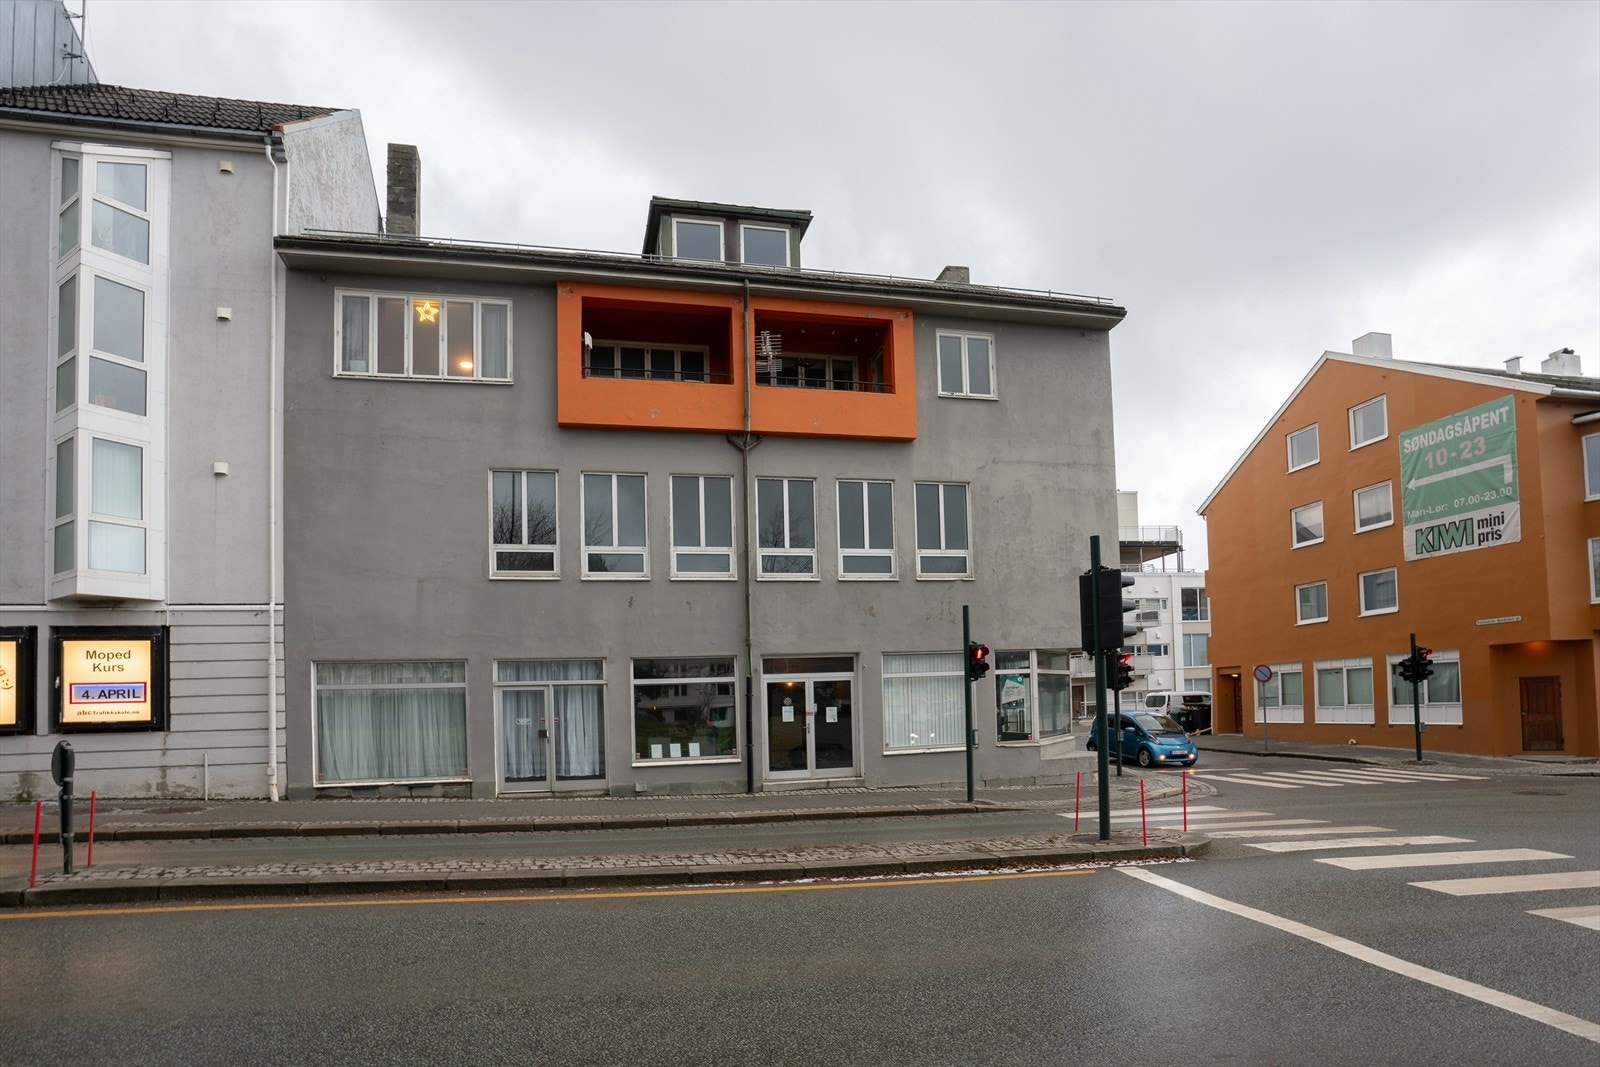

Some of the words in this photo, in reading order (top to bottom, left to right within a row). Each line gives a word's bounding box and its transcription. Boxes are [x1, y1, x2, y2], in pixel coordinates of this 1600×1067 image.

[1403, 406, 1510, 454] SØNDAGSÅPENT
[1424, 447, 1448, 470] 10
[1459, 436, 1487, 460] 23
[1407, 503, 1448, 519] Man-Lør:
[1453, 486, 1513, 508] 07.00-23.00
[1477, 511, 1505, 530] mini
[1415, 517, 1475, 555] KIWI
[1477, 527, 1502, 546] pris
[85, 649, 131, 662] Moped
[92, 662, 125, 673] Kurs
[81, 689, 95, 700] 4.
[97, 689, 141, 699] APRIL
